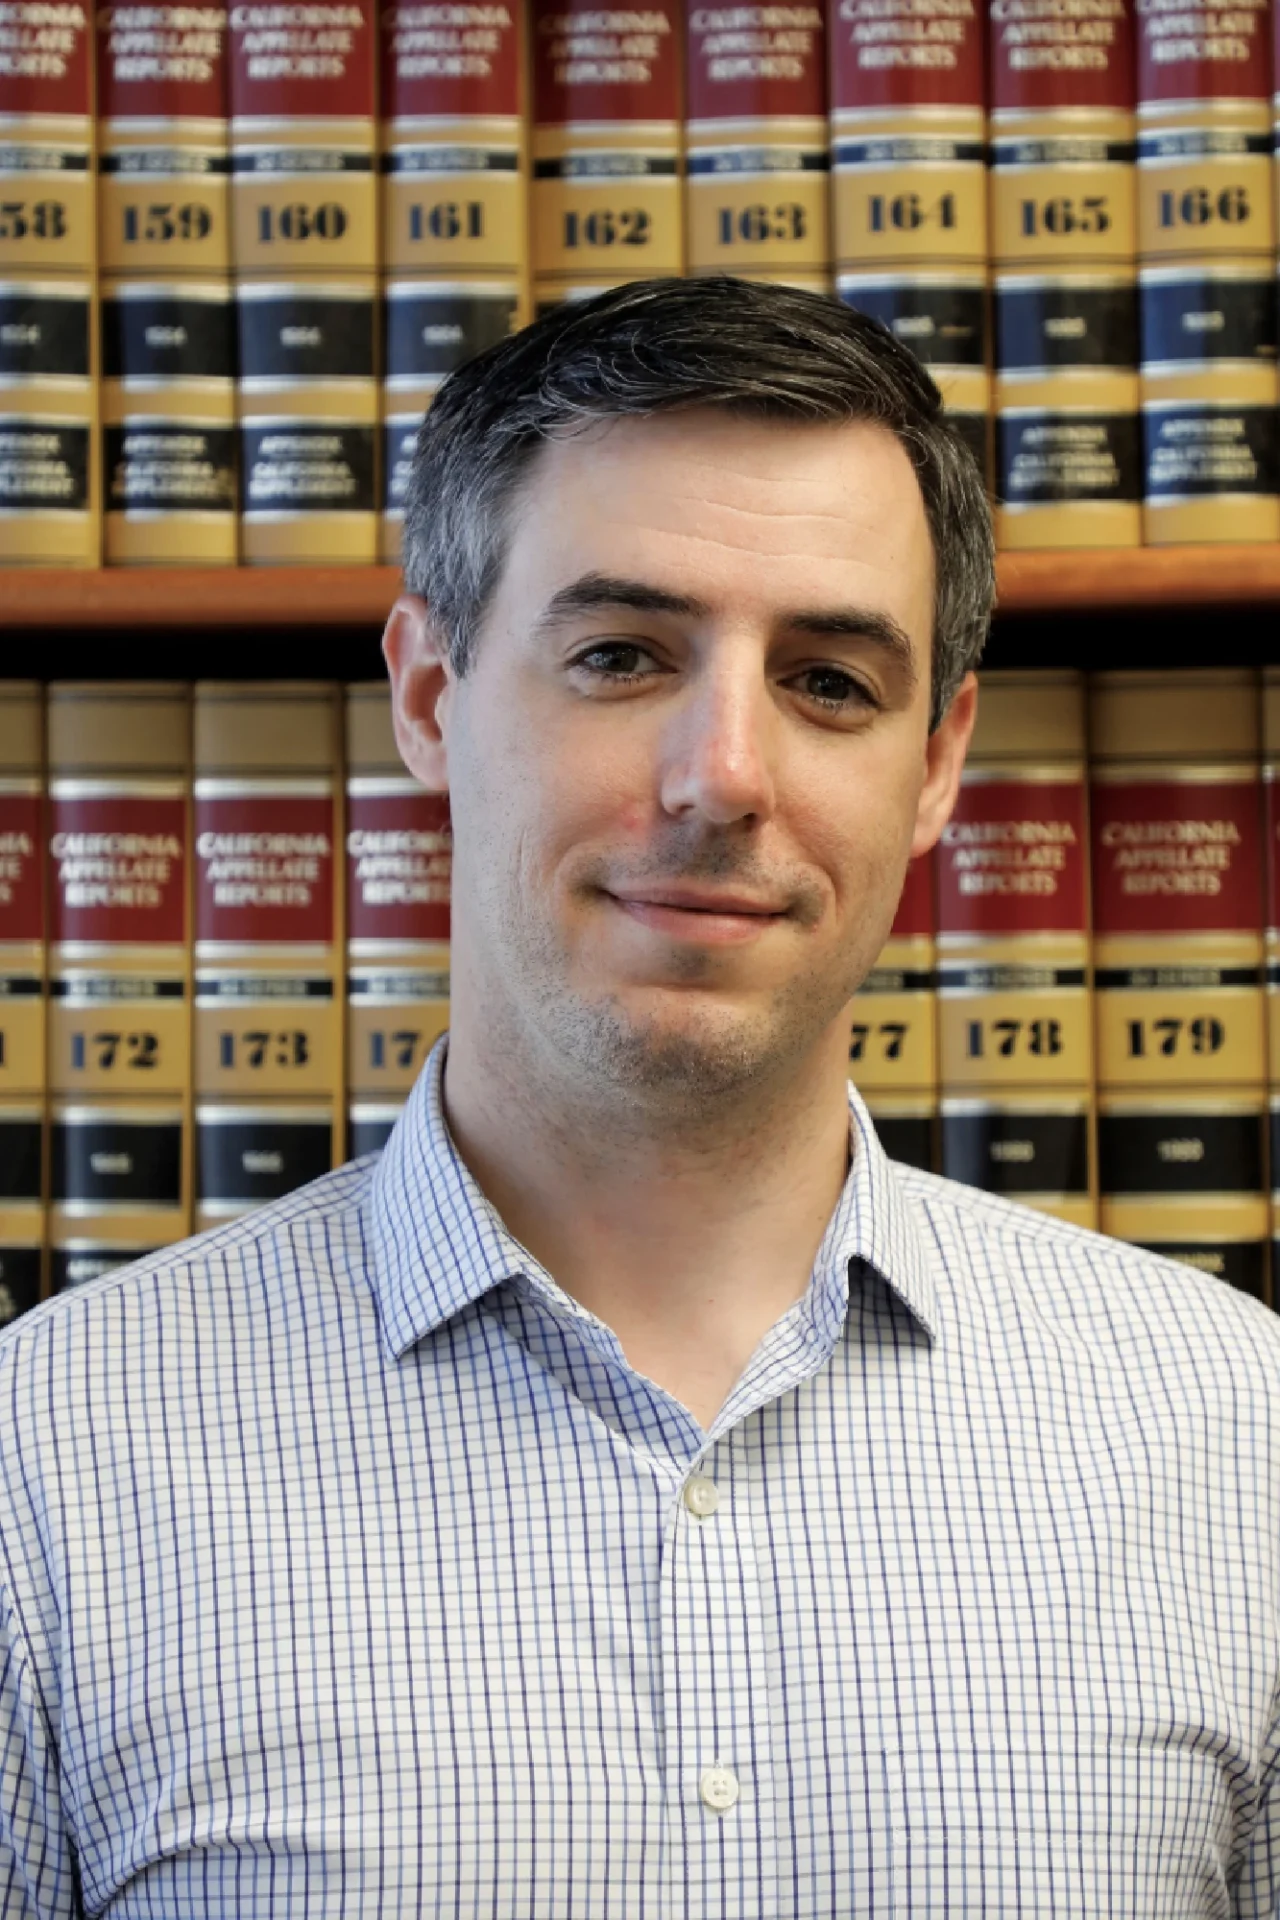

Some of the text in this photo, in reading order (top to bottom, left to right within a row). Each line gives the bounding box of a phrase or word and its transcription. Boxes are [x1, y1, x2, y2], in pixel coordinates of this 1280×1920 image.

[849, 22, 965, 44] APPELLATE
[1001, 22, 1116, 44] APPELLATE
[1144, 12, 1257, 36] APPELLATE
[857, 46, 958, 69] REPORTS
[1008, 46, 1109, 69] REPORTS
[1151, 38, 1250, 61] REPORTS
[0, 202, 66, 239] 58
[868, 191, 957, 232] 164
[1021, 196, 1110, 236] 165
[1158, 186, 1250, 229] 166
[123, 203, 212, 241] 159
[256, 203, 347, 241] 160
[409, 201, 482, 241] 161
[563, 208, 650, 248] 162
[718, 202, 807, 244] 163
[49, 832, 181, 858] CALIFORNIA
[196, 832, 330, 858] CALIFORNIA
[942, 821, 1077, 845] CALIFORNIA
[1101, 820, 1242, 846] CALIFORNIA
[58, 858, 171, 881] APPELLATE
[206, 858, 319, 882] APPELLATE
[952, 846, 1066, 871] APPELLATE
[1113, 845, 1232, 871] APPELLATE
[65, 883, 163, 908] REPORTS
[213, 882, 311, 907] REPORTS
[958, 870, 1057, 896] REPORTS
[1122, 870, 1221, 896] REPORTS
[71, 1031, 159, 1070] 172
[219, 1031, 310, 1069] 173
[370, 1031, 421, 1069] 17
[849, 1022, 908, 1061] 77
[966, 1018, 1063, 1058] 178
[1128, 1016, 1225, 1059] 179
